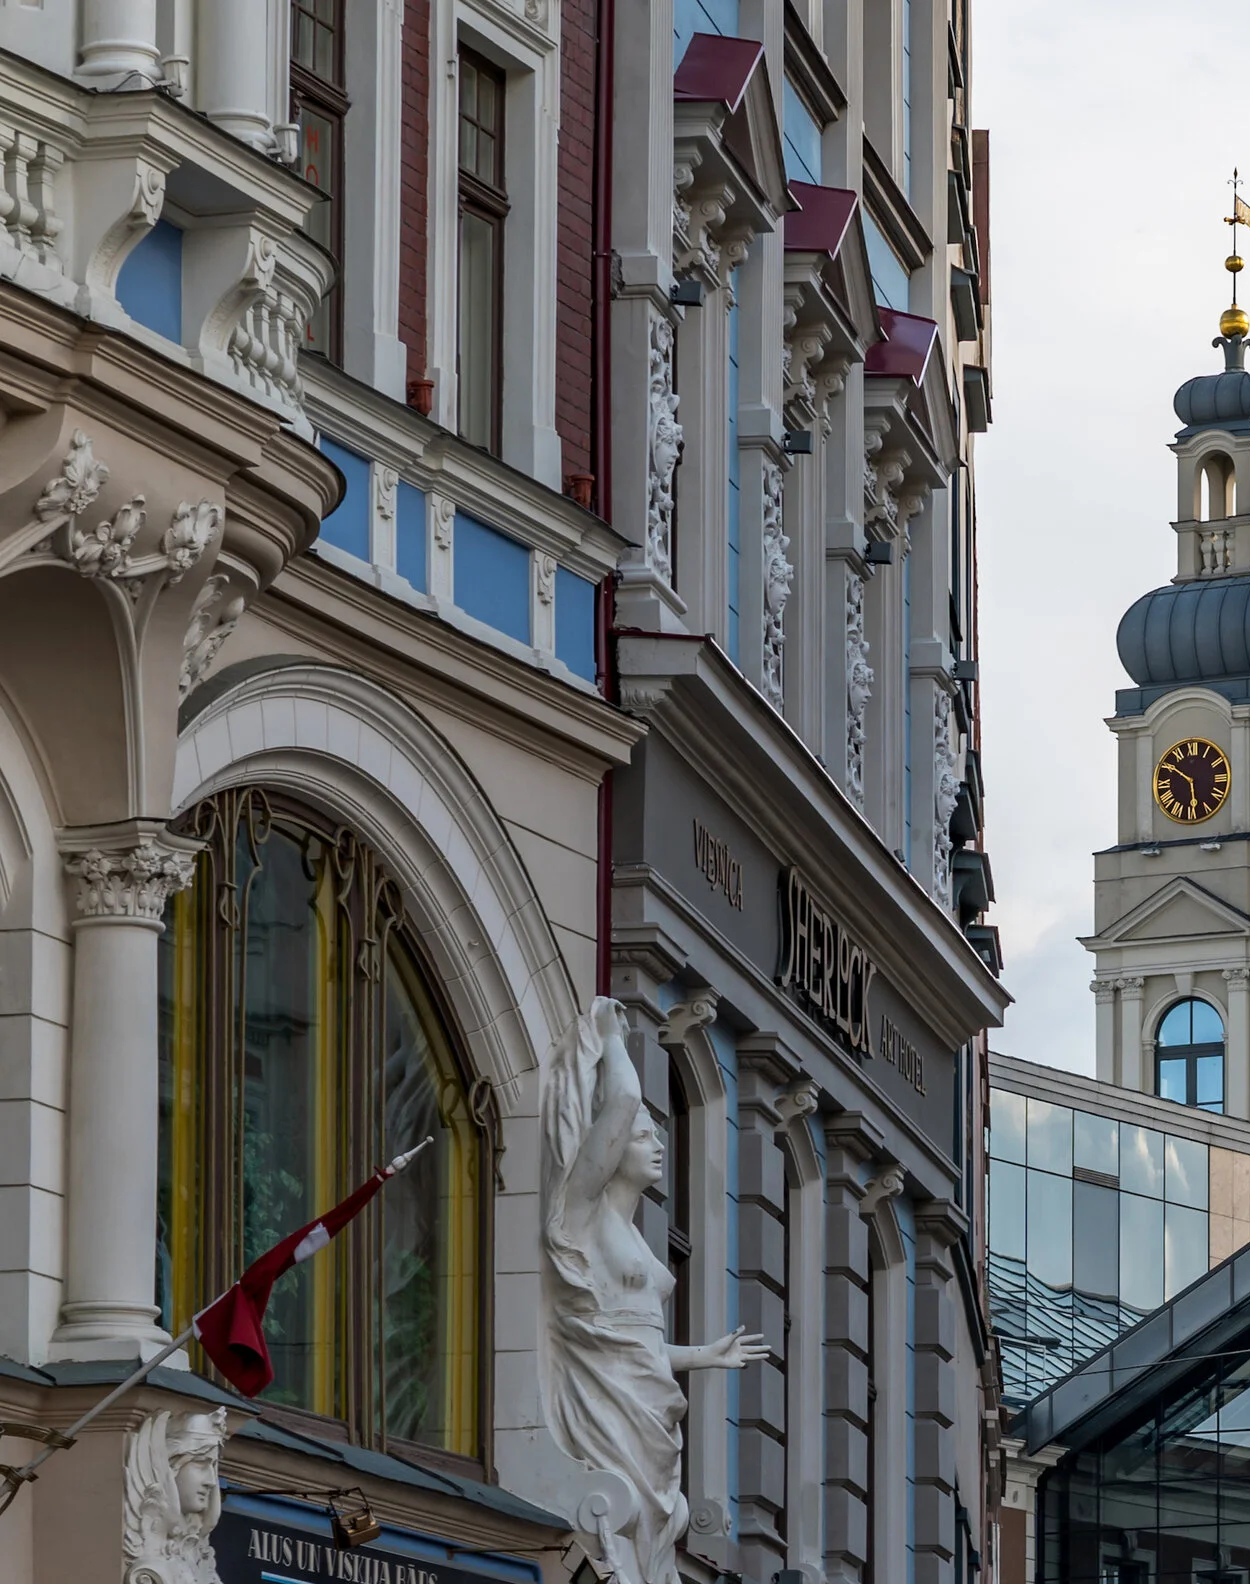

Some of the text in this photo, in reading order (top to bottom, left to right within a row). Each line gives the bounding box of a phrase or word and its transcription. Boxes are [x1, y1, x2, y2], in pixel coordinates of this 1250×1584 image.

[778, 864, 876, 1059] SHERLOCK
[880, 1014, 926, 1097] ART HOTEL
[247, 1528, 293, 1568] ALUS
[295, 1539, 321, 1574] UN
